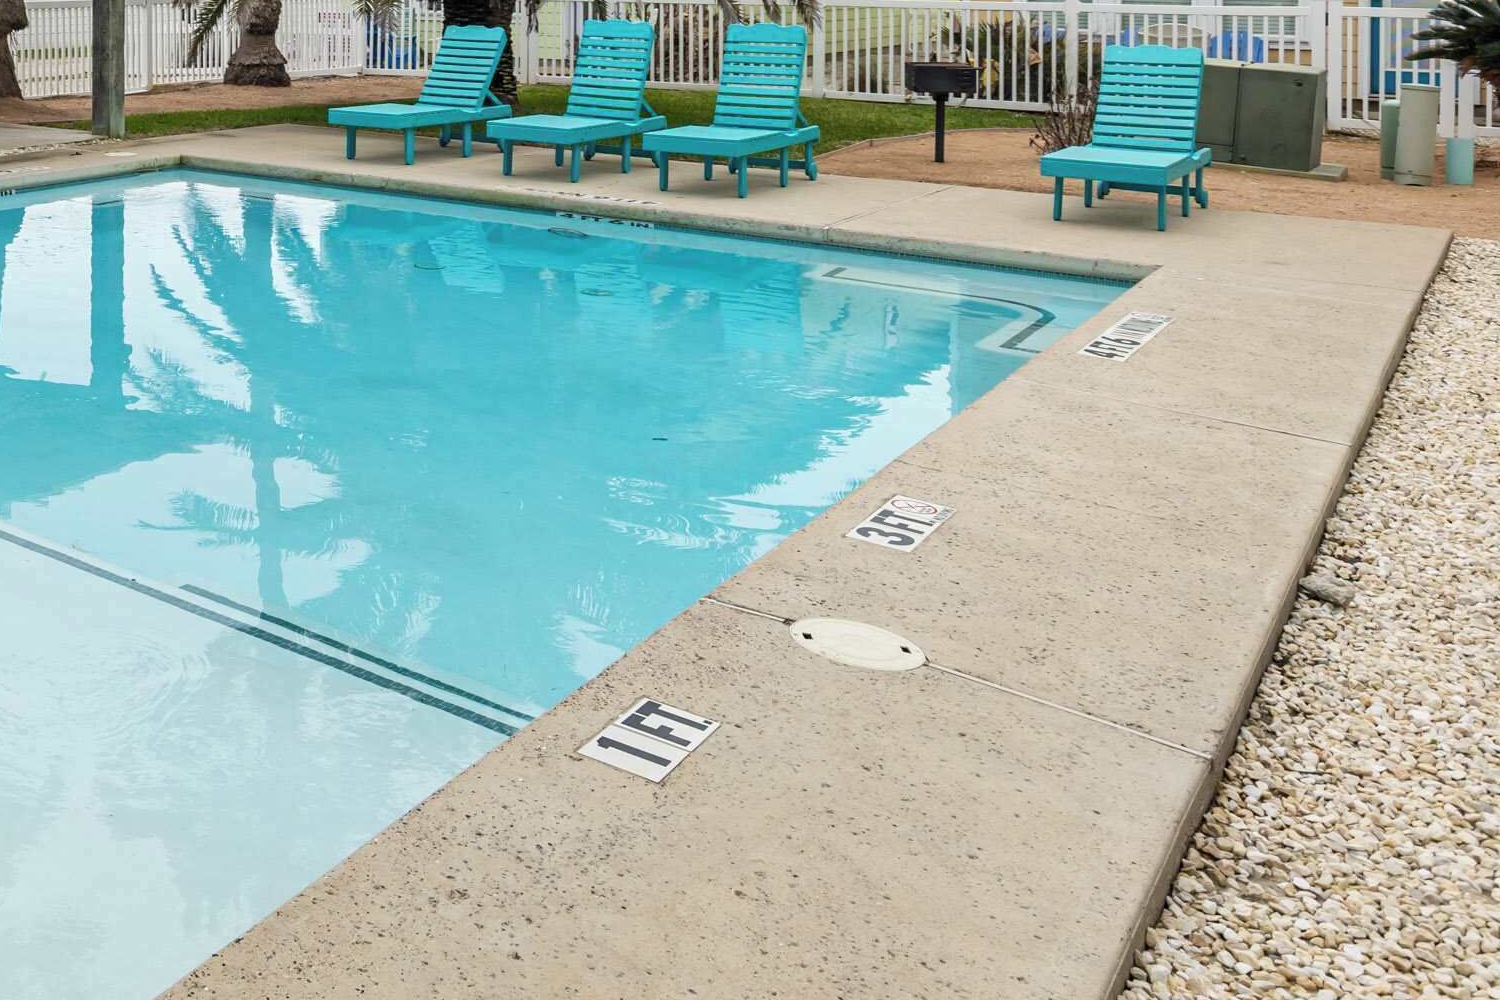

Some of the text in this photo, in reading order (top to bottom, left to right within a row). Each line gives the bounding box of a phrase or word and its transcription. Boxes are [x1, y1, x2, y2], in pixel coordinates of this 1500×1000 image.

[1089, 340, 1134, 354] FT
[1101, 335, 1141, 346] 6
[1083, 348, 1125, 359] 4
[856, 526, 916, 546] 3
[596, 735, 672, 768] 1
